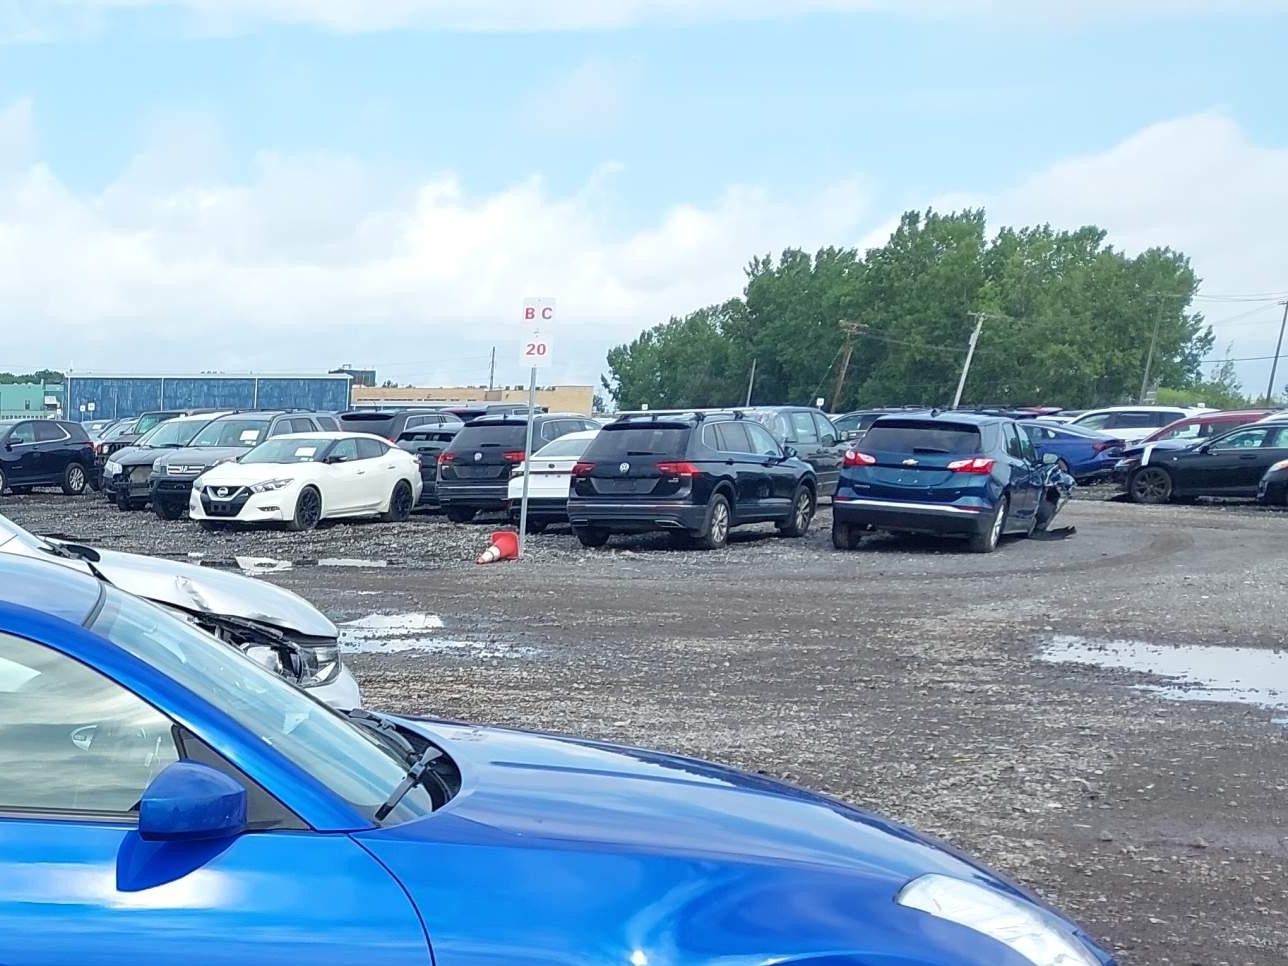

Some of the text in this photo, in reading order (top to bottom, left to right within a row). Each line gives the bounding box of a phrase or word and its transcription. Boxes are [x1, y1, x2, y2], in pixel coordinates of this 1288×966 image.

[525, 307, 553, 320] B C
[526, 343, 546, 355] 20
